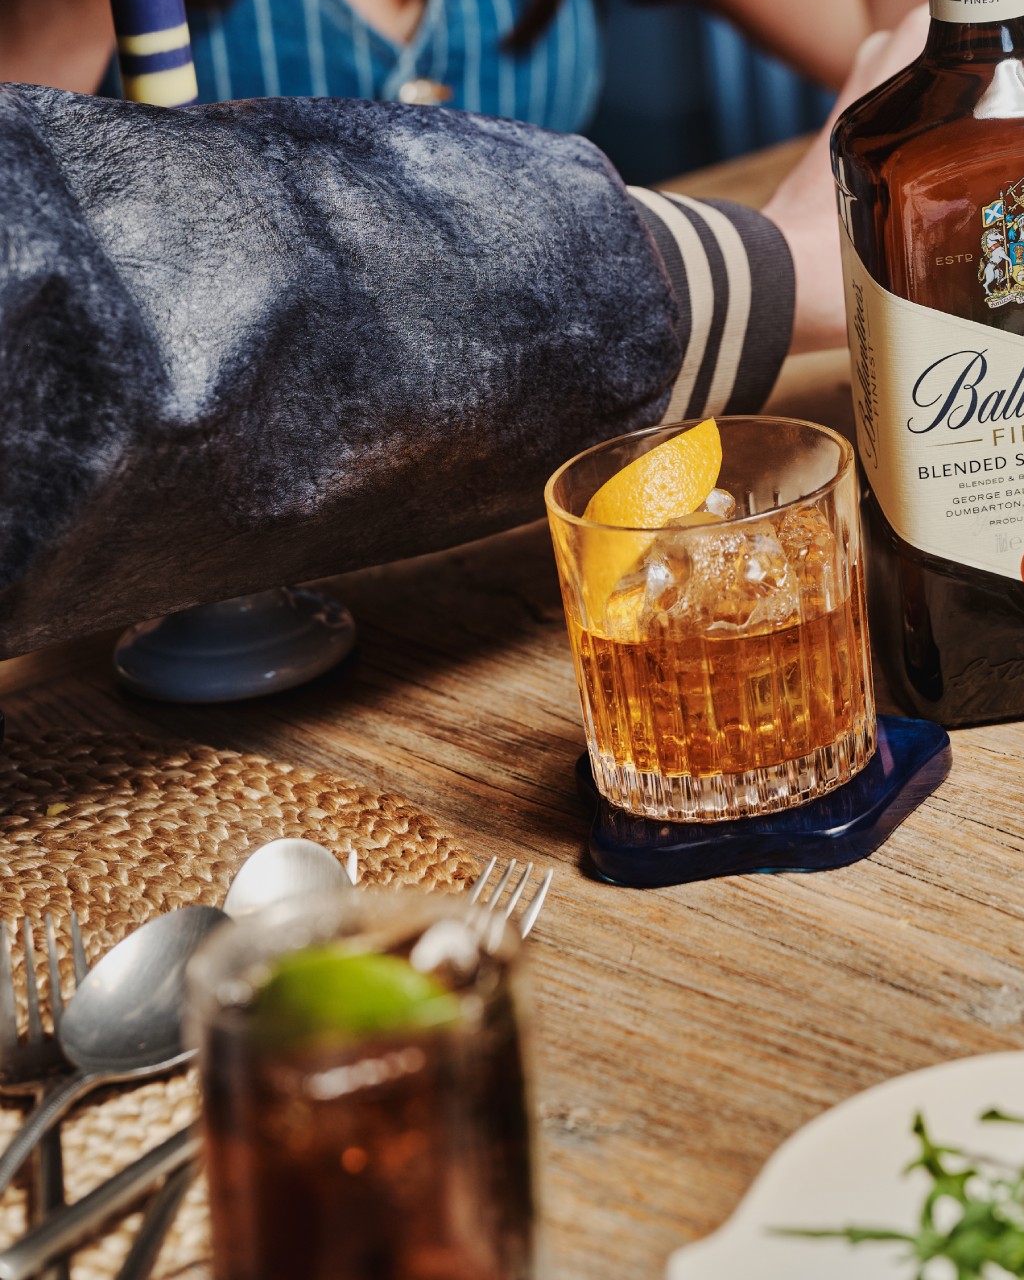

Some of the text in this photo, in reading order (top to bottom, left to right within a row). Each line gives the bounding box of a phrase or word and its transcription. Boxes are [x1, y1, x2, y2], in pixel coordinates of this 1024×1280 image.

[935, 253, 974, 266] ESTD
[852, 278, 879, 470] Ballantine's
[867, 344, 880, 417] FINEST
[918, 456, 1007, 480] BLENDED
[958, 477, 1005, 489] BLENDED
[952, 491, 1001, 505] GEORGE
[945, 500, 1024, 518] DUMBARTON,
